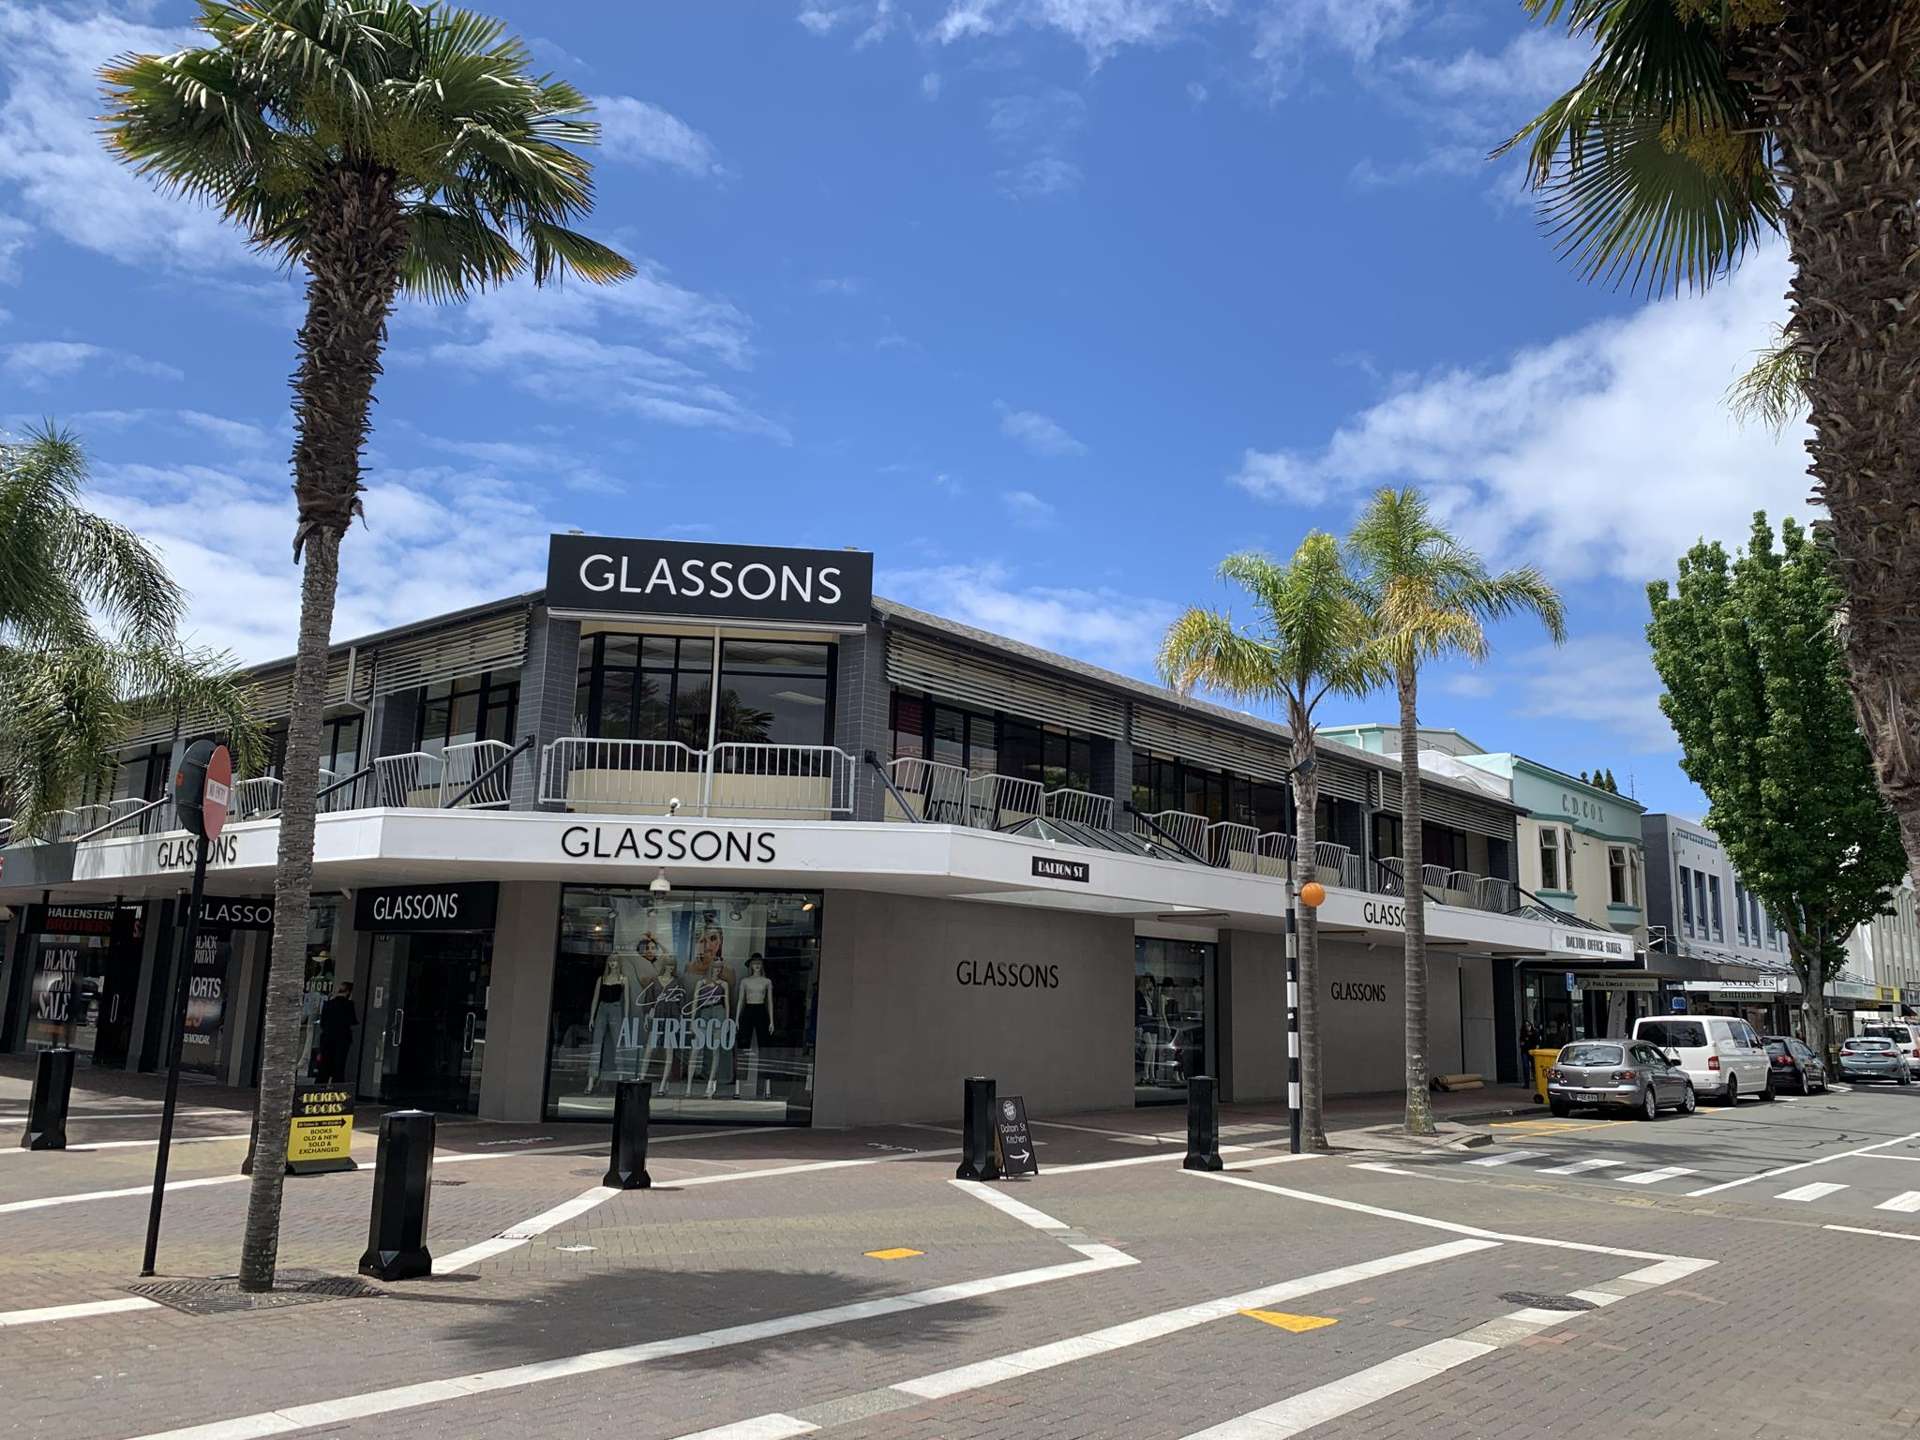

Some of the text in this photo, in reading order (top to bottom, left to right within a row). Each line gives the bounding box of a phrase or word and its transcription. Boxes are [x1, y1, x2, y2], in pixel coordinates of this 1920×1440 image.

[579, 554, 842, 605] GLASSONS
[561, 826, 776, 863] GLASSONS
[1038, 861, 1084, 878] DALTON ST
[47, 907, 114, 920] HALLENSTEIN
[373, 893, 459, 920] GLASSONS
[43, 949, 77, 970] BLACK
[956, 960, 1059, 988] GLASSONS
[1331, 982, 1386, 1002] GLASSONS
[37, 991, 72, 1021] SALE
[616, 1018, 736, 1050] AL FRESCO
[303, 1092, 347, 1103] DICKENS
[305, 1104, 342, 1114] BOOKS
[1000, 1122, 1019, 1134] Dalton
[1006, 1134, 1027, 1145] Kitchen
